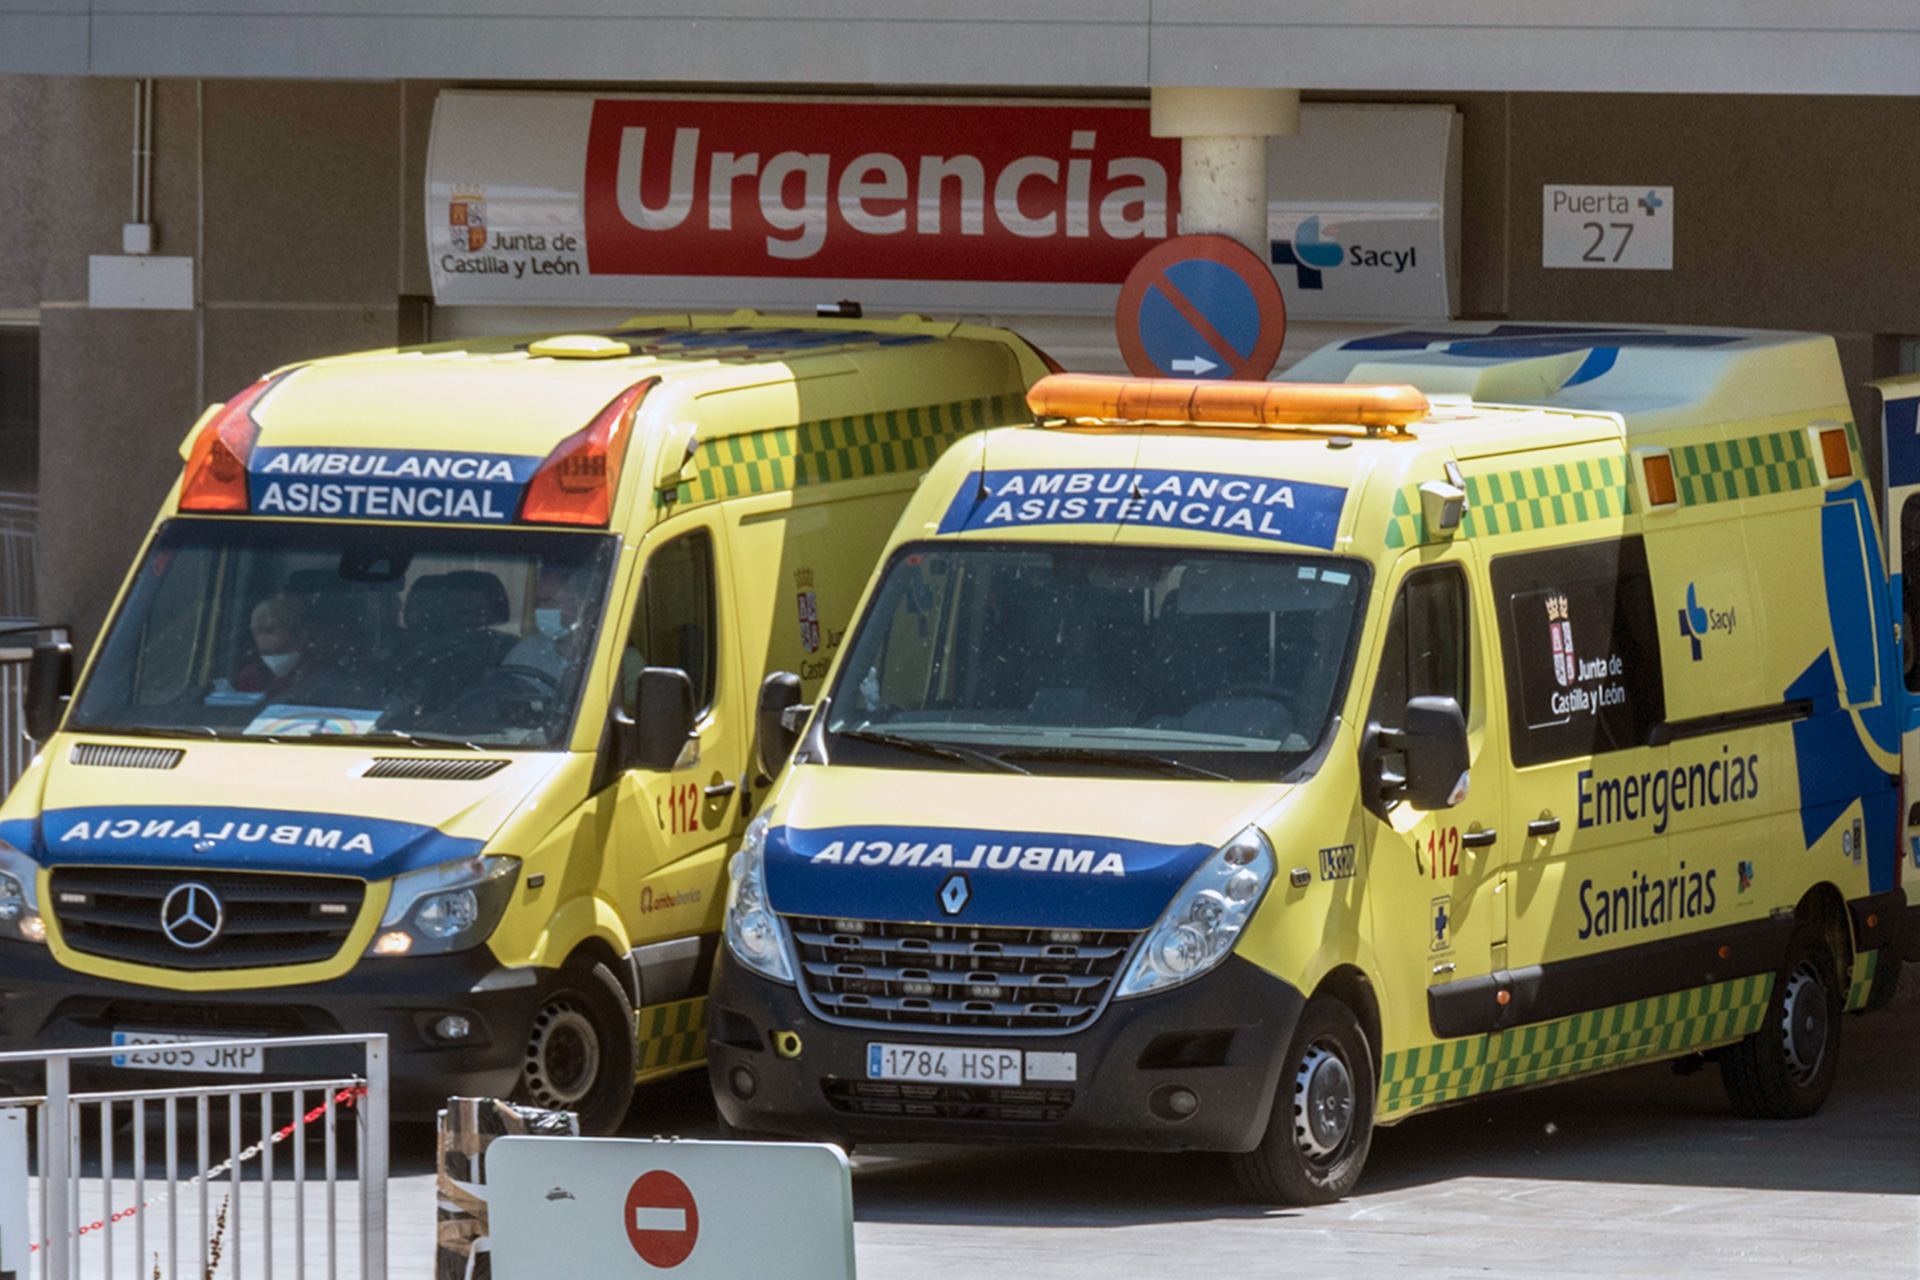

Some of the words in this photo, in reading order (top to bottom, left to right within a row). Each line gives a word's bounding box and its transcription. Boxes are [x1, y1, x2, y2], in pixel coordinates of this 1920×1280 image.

[616, 125, 1182, 260] Urgencia
[1553, 190, 1630, 215] Puerta
[492, 231, 546, 251] Junta
[552, 233, 578, 252] de
[1581, 222, 1635, 263] 27
[441, 254, 510, 274] Castilla
[513, 261, 526, 279] y
[531, 256, 580, 275] León
[1350, 245, 1417, 273] Sacyl
[262, 452, 514, 482] AMBULANCIA
[259, 482, 504, 519] ASISTENCIAL
[996, 473, 1295, 509] AMBULANCIA
[985, 497, 1282, 536] ASISTENCIAL
[1709, 607, 1736, 635] Sacyl
[1578, 657, 1607, 681] Junta
[1608, 654, 1623, 676] de
[1551, 687, 1590, 715] Castilla
[1590, 690, 1598, 715] y
[1598, 682, 1626, 706] León
[1577, 744, 1759, 834] Emergencias
[668, 782, 699, 835] 112
[1428, 826, 1459, 879] 112
[1578, 860, 1717, 940] Sanitarias
[205, 1047, 256, 1069] JRP
[889, 1050, 947, 1078] 1784
[962, 1053, 1013, 1080] HSP
